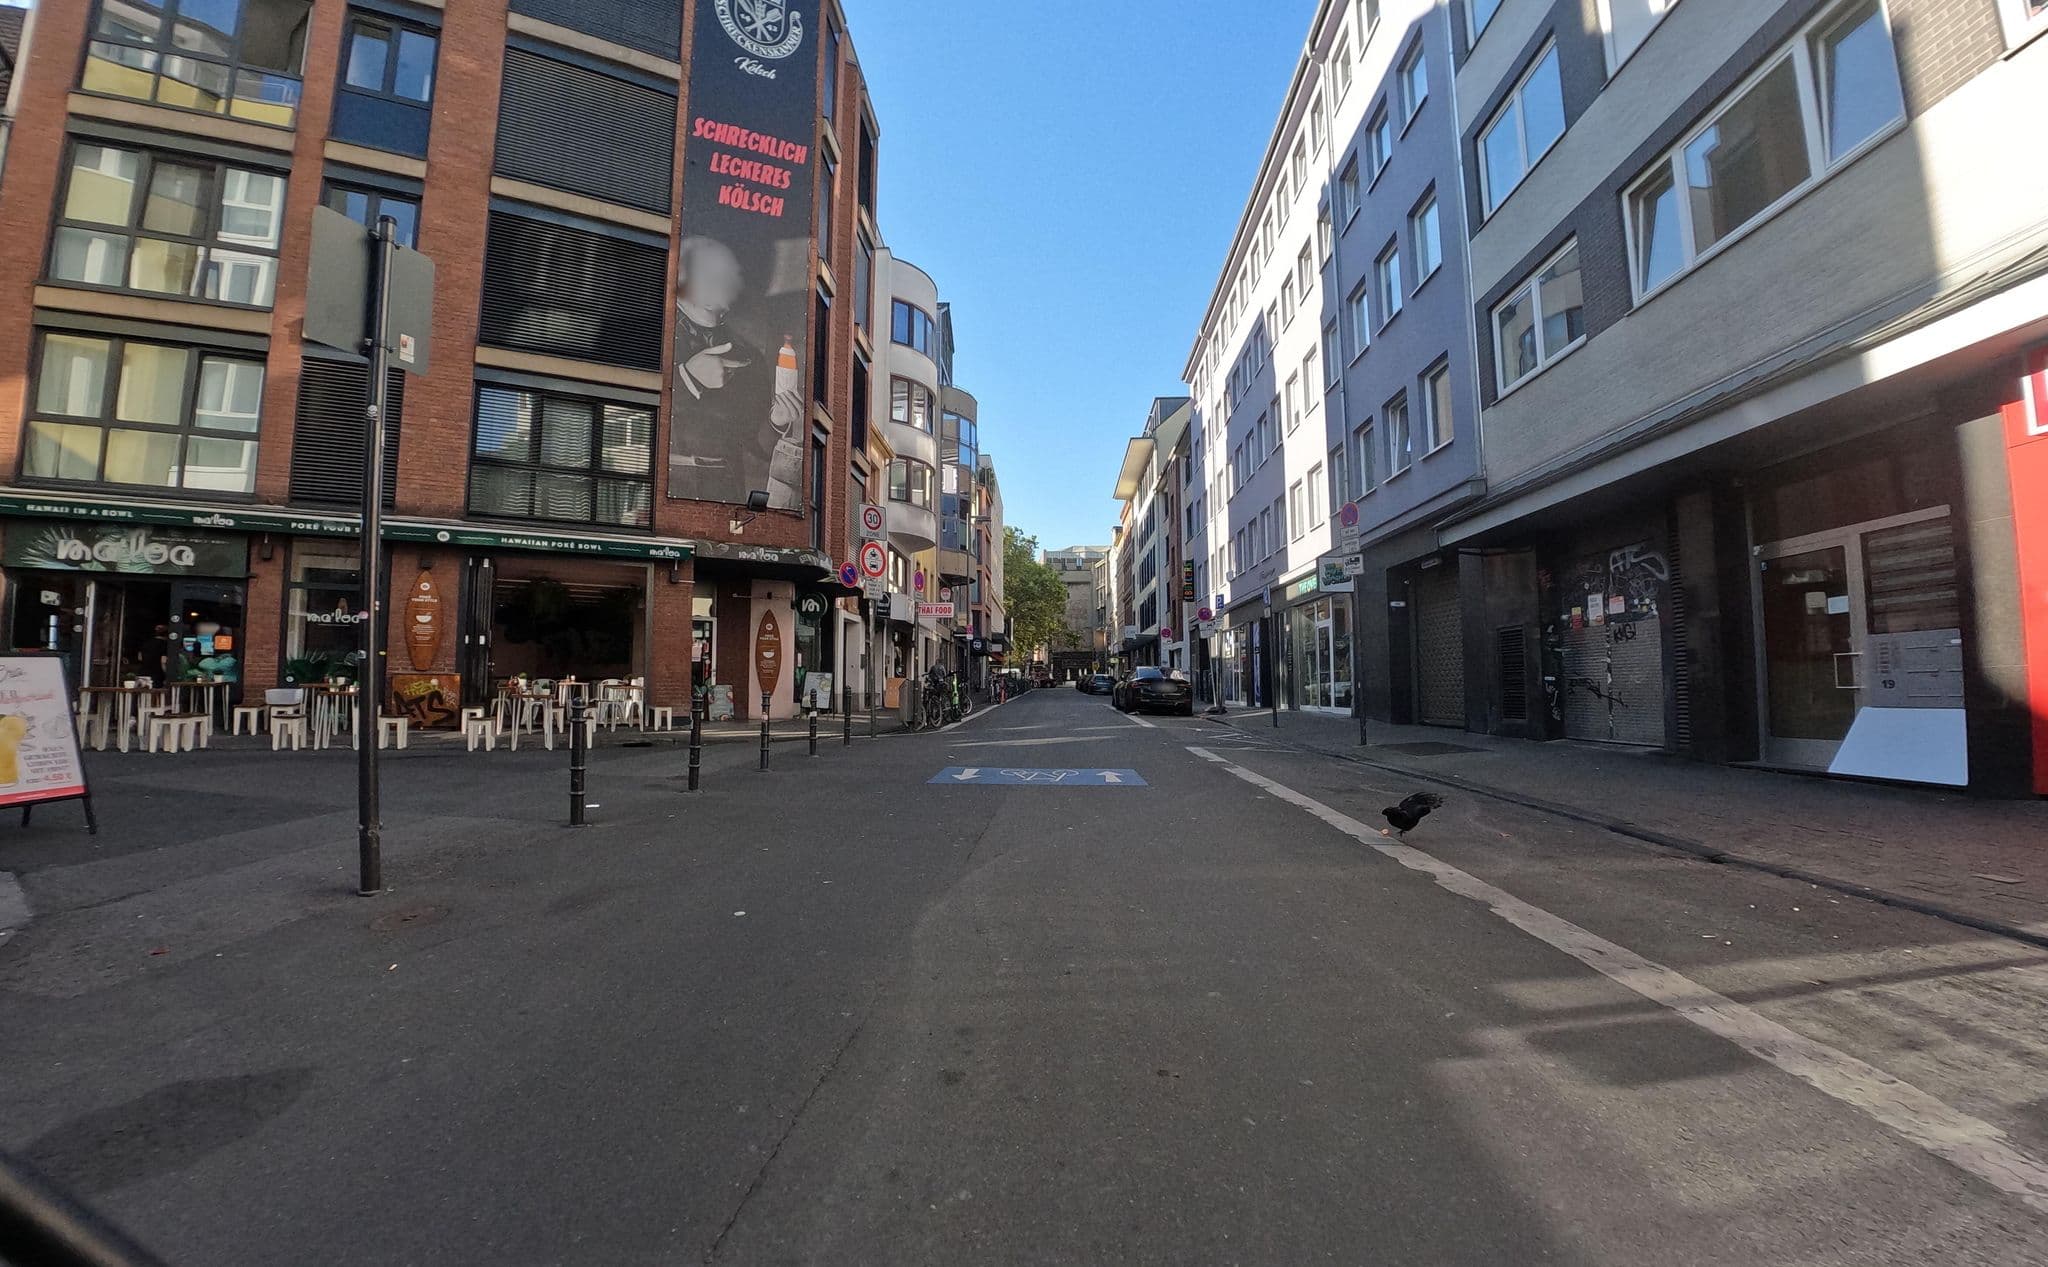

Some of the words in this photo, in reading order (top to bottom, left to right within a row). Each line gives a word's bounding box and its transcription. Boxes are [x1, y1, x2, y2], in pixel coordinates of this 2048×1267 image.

[734, 57, 776, 79] Kölsch
[692, 117, 808, 164] SCHRECKLICH
[709, 152, 792, 189] LECKERES
[718, 183, 785, 217] KÖLSCH
[26, 504, 69, 514] HAWAII
[73, 507, 87, 515] IN
[101, 509, 134, 518] BOWL
[867, 513, 878, 525] 30
[501, 537, 549, 547] HAWAIIAN
[551, 540, 575, 549] POKÉ
[578, 543, 603, 551] BOWL
[918, 606, 934, 614] THAI
[934, 606, 953, 614] FOOD
[1881, 679, 1896, 690] 19
